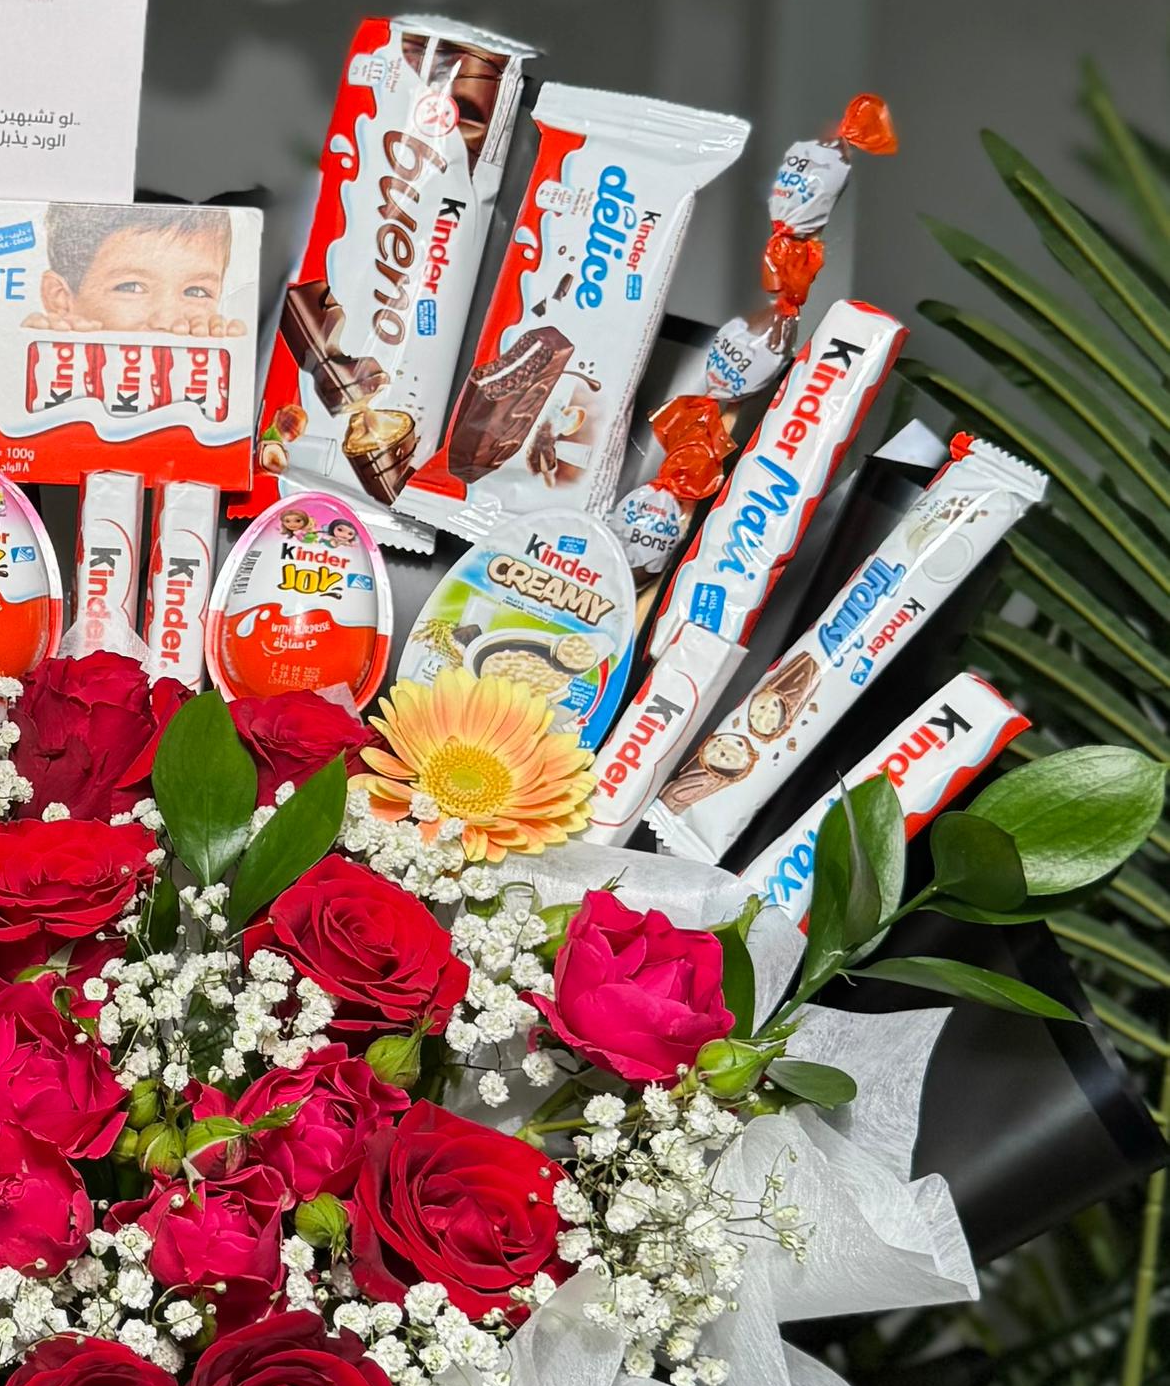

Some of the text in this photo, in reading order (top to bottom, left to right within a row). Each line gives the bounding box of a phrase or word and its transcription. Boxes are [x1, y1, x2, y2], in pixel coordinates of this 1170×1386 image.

[31, 133, 66, 150] الورد
[373, 130, 446, 346] bueno
[422, 197, 466, 295] Kinder
[626, 210, 662, 272] Kinder
[720, 338, 752, 373] Bons
[773, 337, 865, 462] Kinder
[6, 447, 36, 462] 100g
[630, 527, 668, 552] Bons
[715, 454, 801, 584] Maxi
[277, 564, 344, 594] JOY
[280, 542, 351, 569] Kinder
[524, 533, 603, 587] Kinder
[160, 557, 201, 664] Kinder
[487, 553, 615, 626] CREAMY
[818, 556, 907, 668] Tronky
[271, 621, 291, 633] WITH
[304, 639, 318, 651] مع
[867, 597, 926, 658] Kinder
[598, 693, 685, 800] Kinder
[870, 702, 973, 788] Kind
